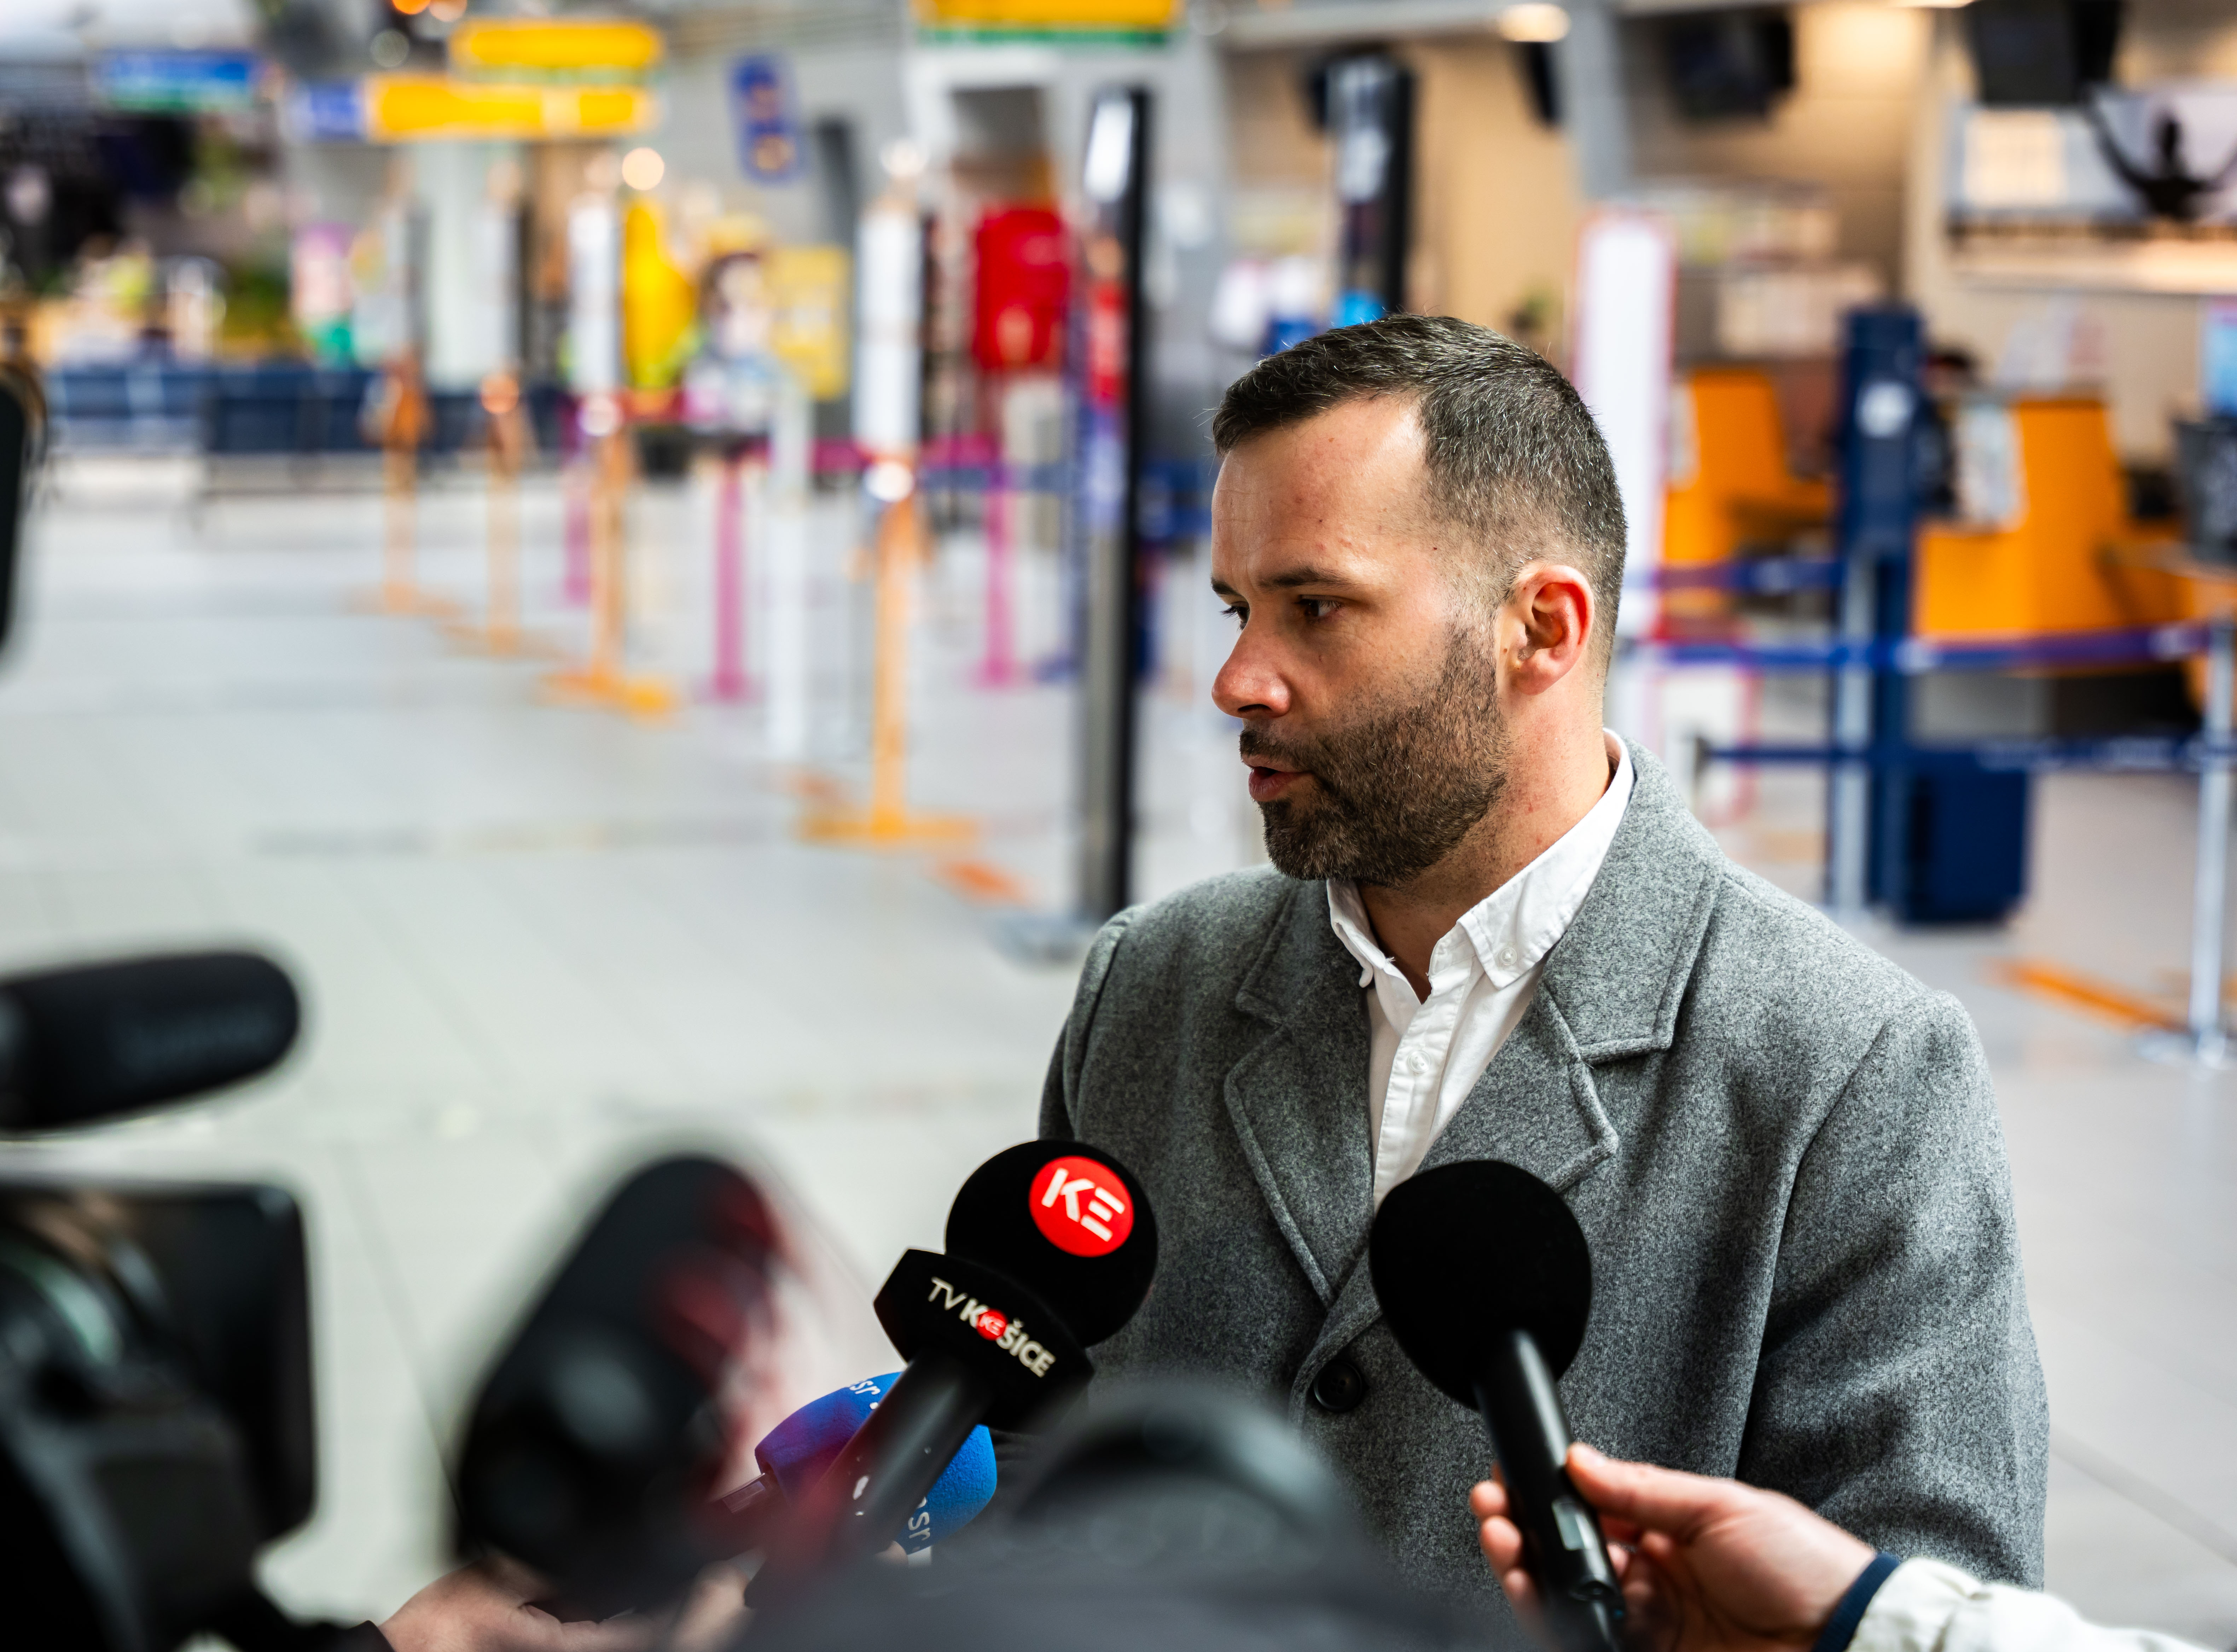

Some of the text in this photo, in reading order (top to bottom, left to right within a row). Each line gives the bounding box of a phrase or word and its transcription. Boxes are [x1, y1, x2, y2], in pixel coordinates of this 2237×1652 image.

[1041, 1168, 1126, 1242] KE
[928, 1276, 968, 1310] TV
[849, 1380, 881, 1395] sr
[908, 1496, 930, 1541] sr
